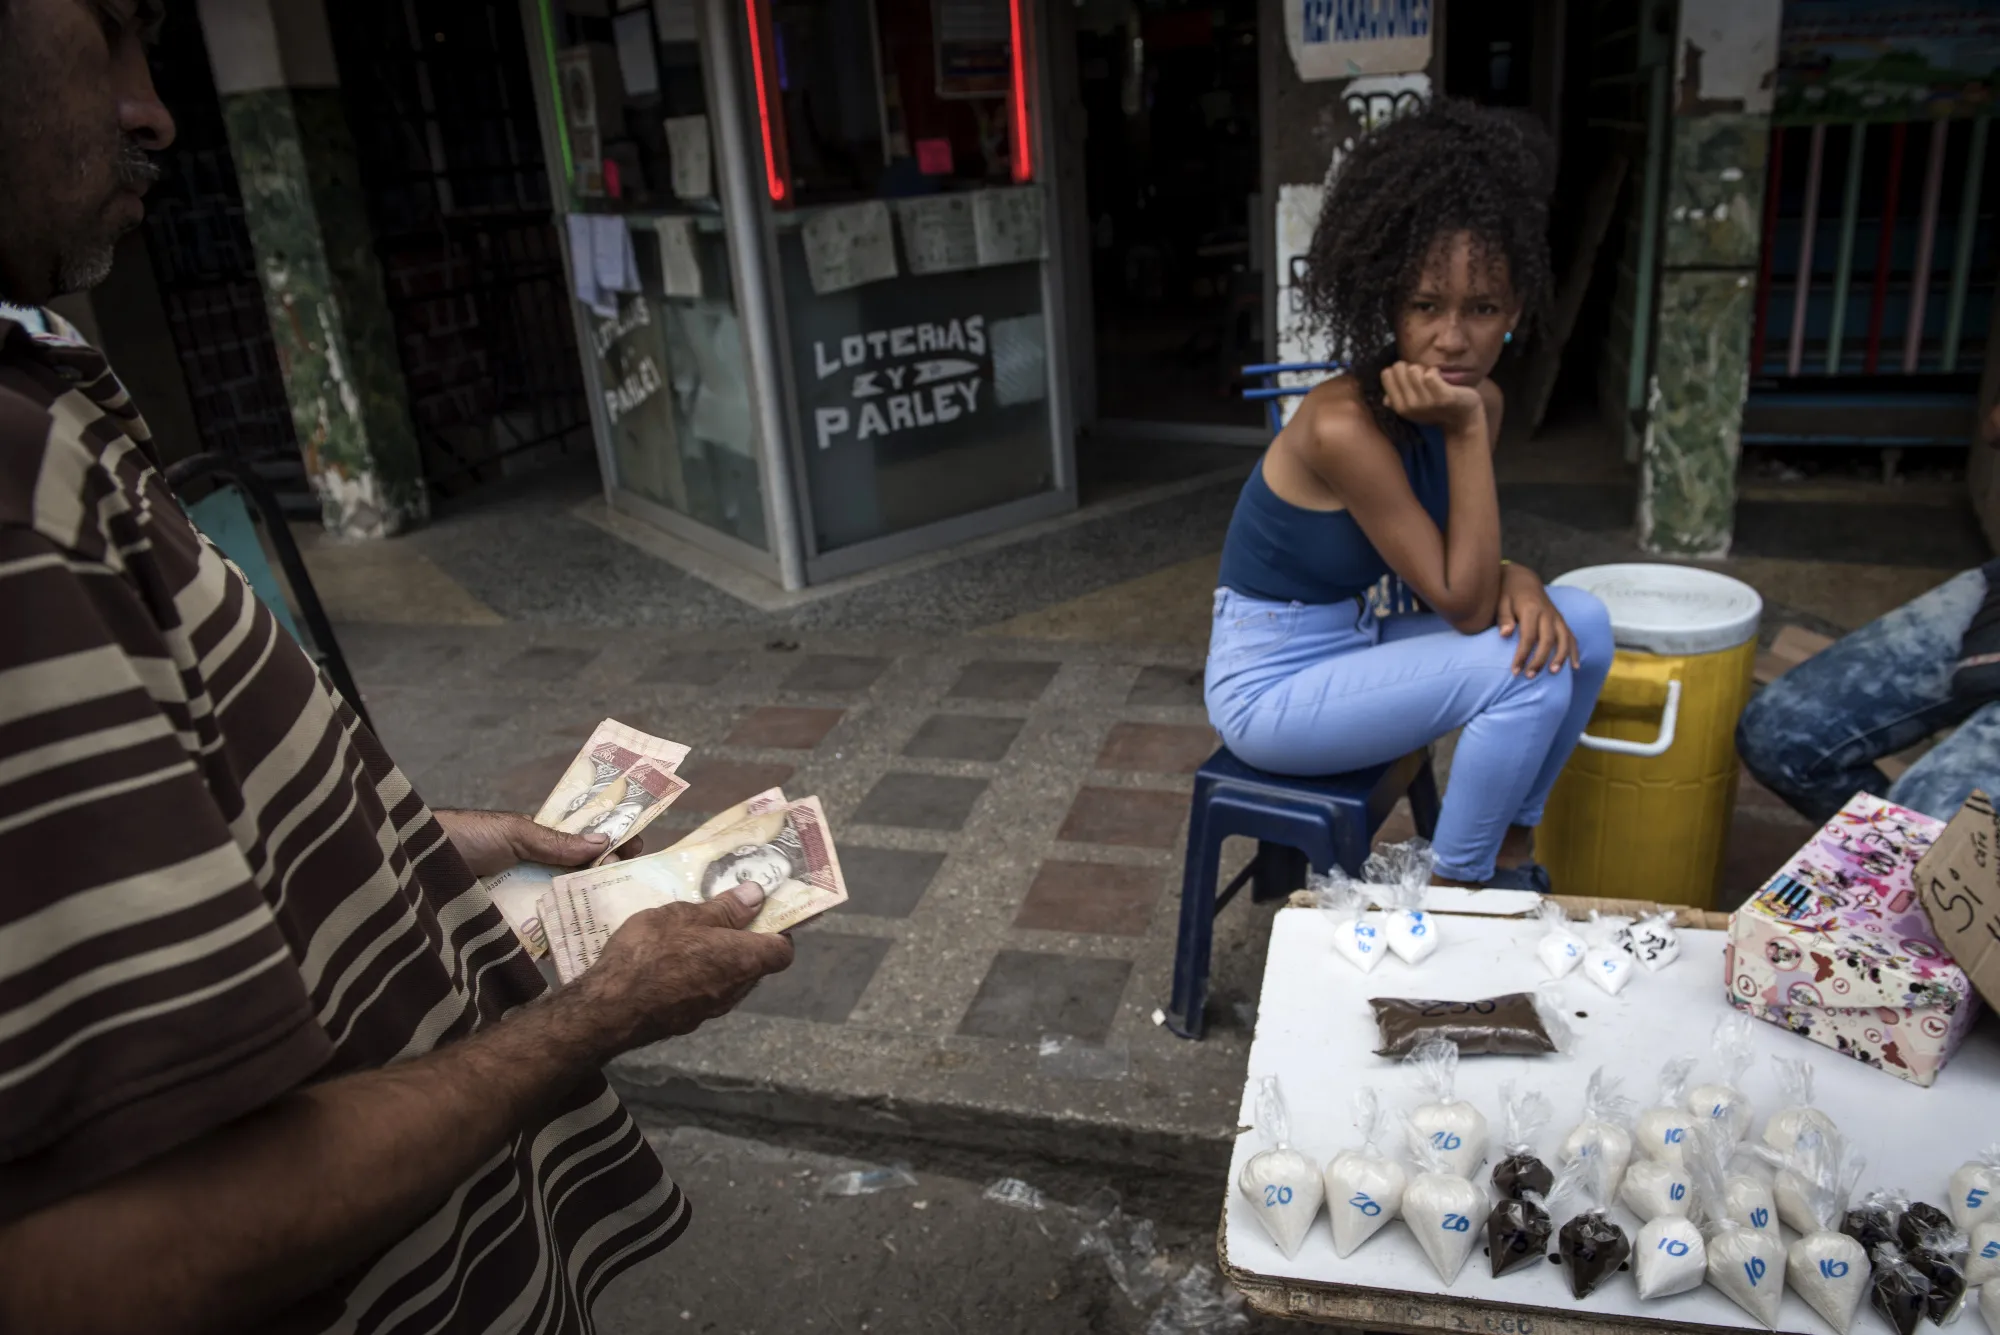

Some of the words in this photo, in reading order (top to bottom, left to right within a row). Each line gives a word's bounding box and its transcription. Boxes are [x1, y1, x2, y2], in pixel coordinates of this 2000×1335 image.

[814, 315, 986, 379] LOTERIAS
[885, 367, 906, 390] Y
[815, 378, 981, 449] PARLEY
[1264, 1184, 1293, 1208] 20
[1669, 1182, 1686, 1201] 10
[1965, 1188, 1990, 1209] 5
[1657, 1237, 1690, 1257] 10
[1744, 1256, 1767, 1288] 10
